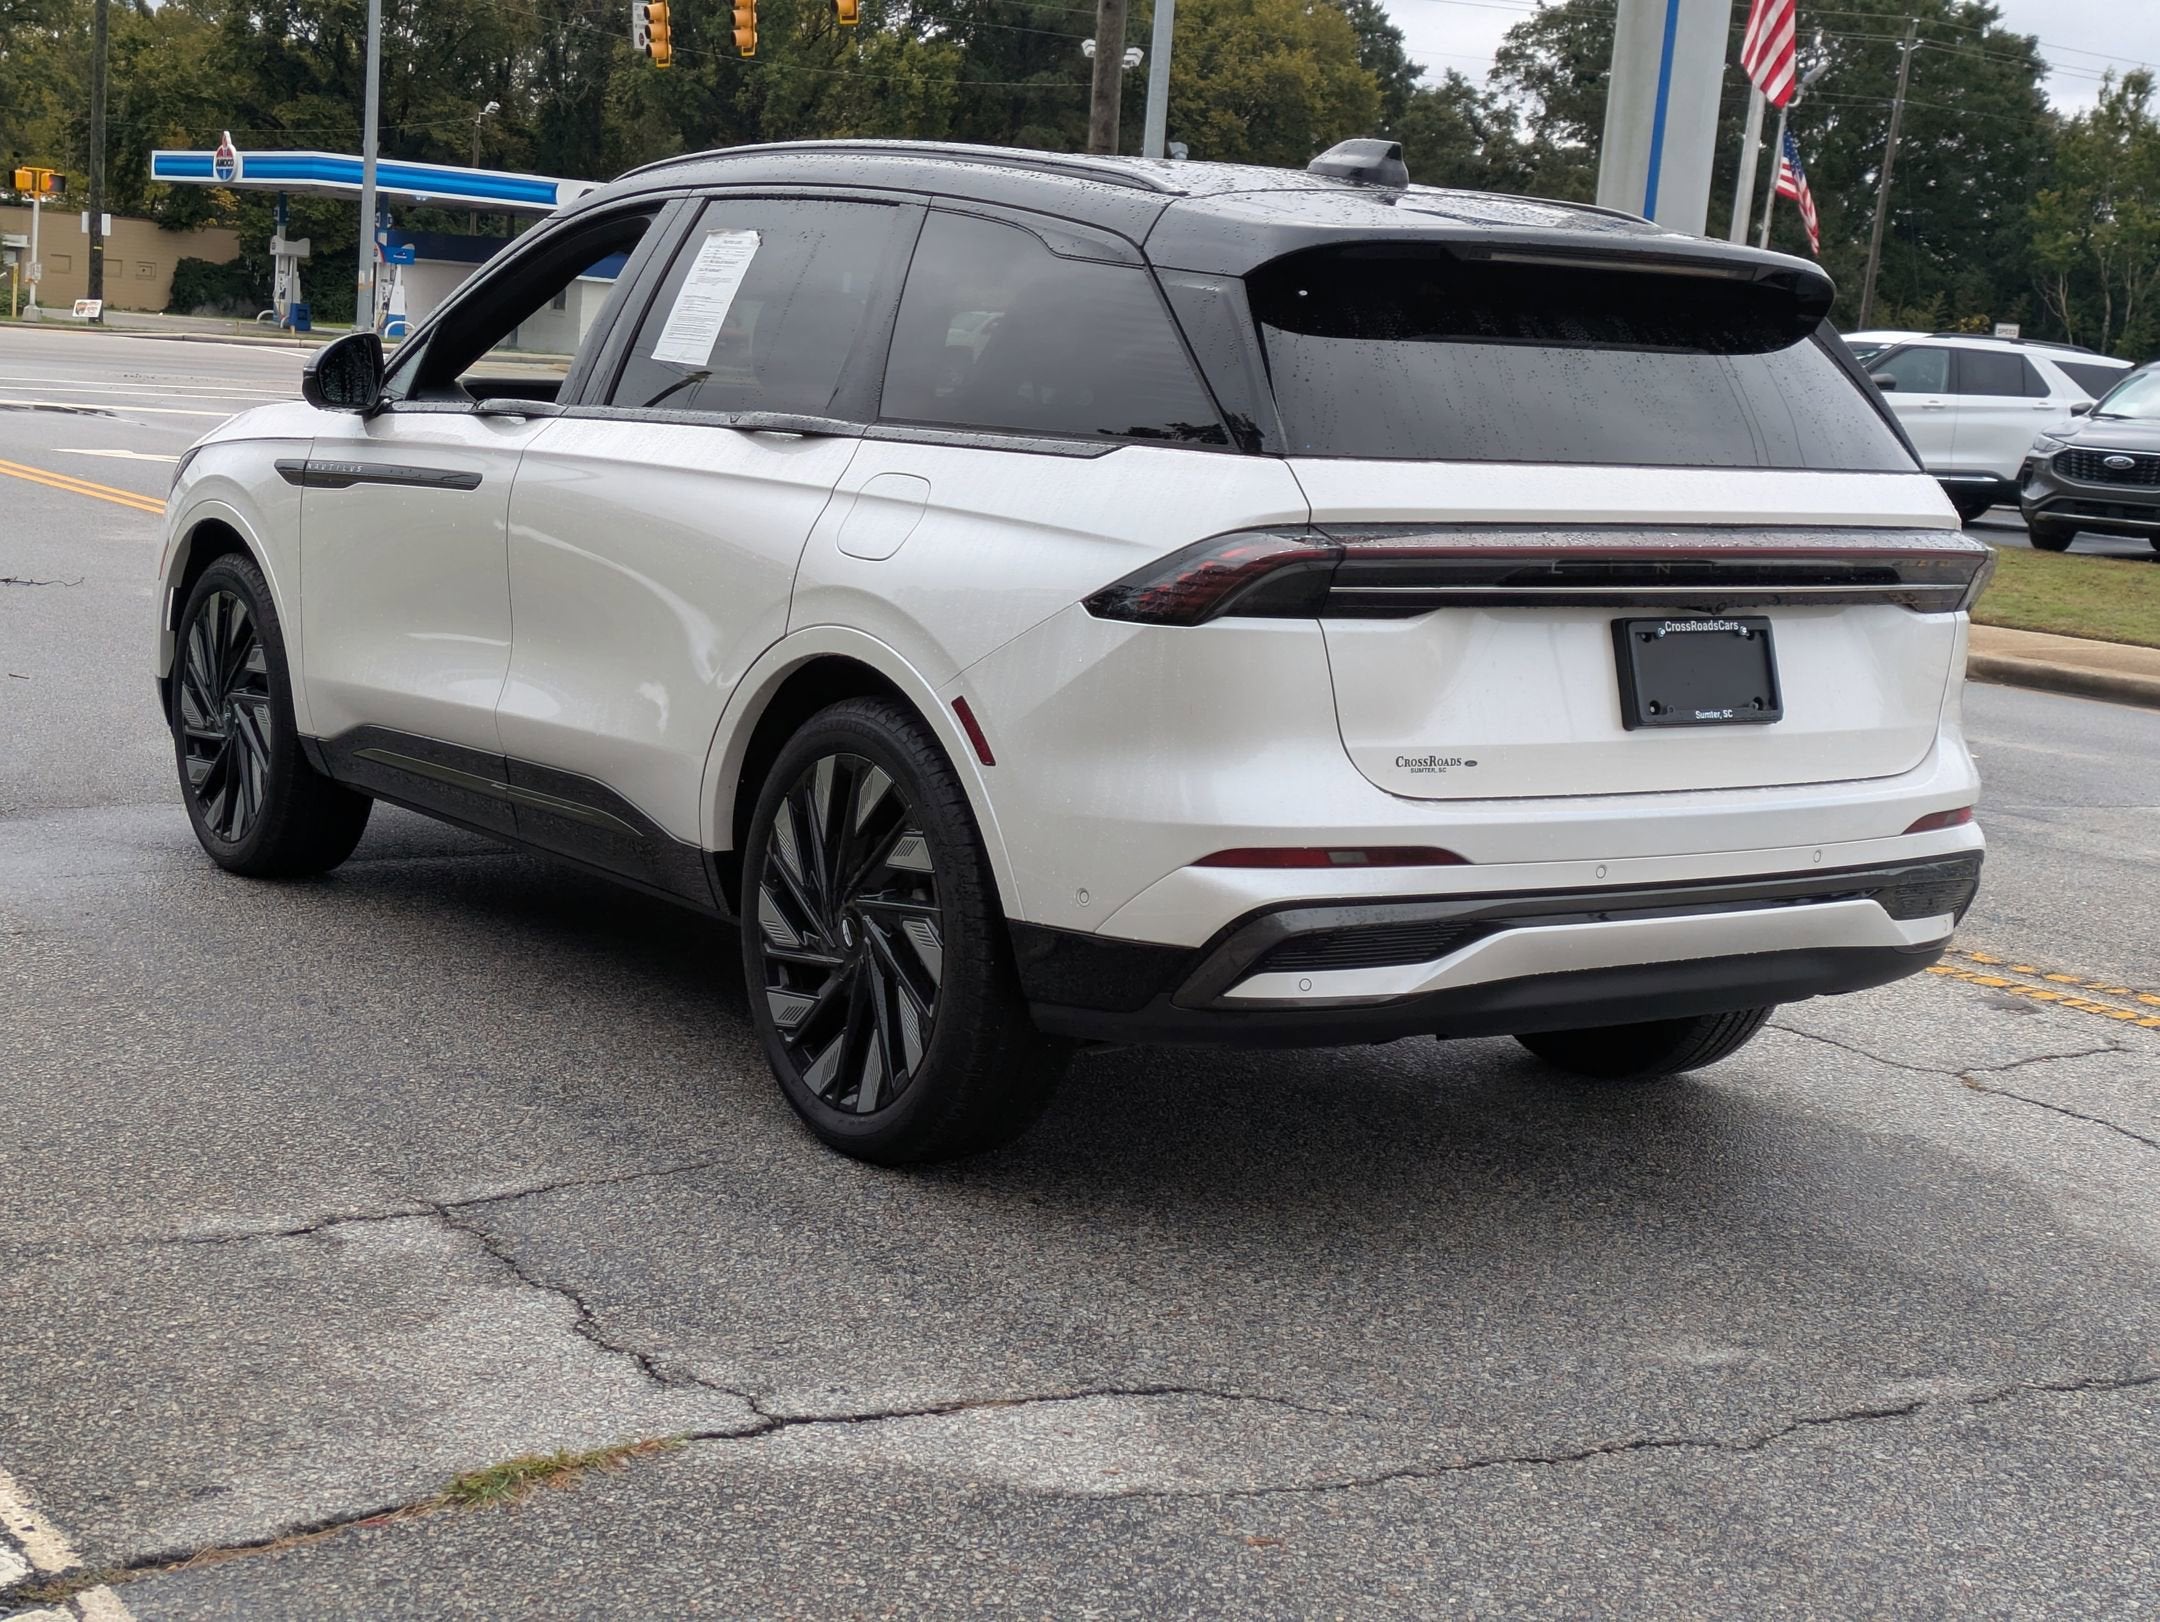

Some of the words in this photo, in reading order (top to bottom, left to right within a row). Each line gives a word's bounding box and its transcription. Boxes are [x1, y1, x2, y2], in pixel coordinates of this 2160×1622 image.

[307, 462, 364, 473] NAUTILUS
[1664, 619, 1739, 632] CrossRoadsCars
[1695, 710, 1722, 720] Sumter,
[1723, 709, 1734, 718] SC
